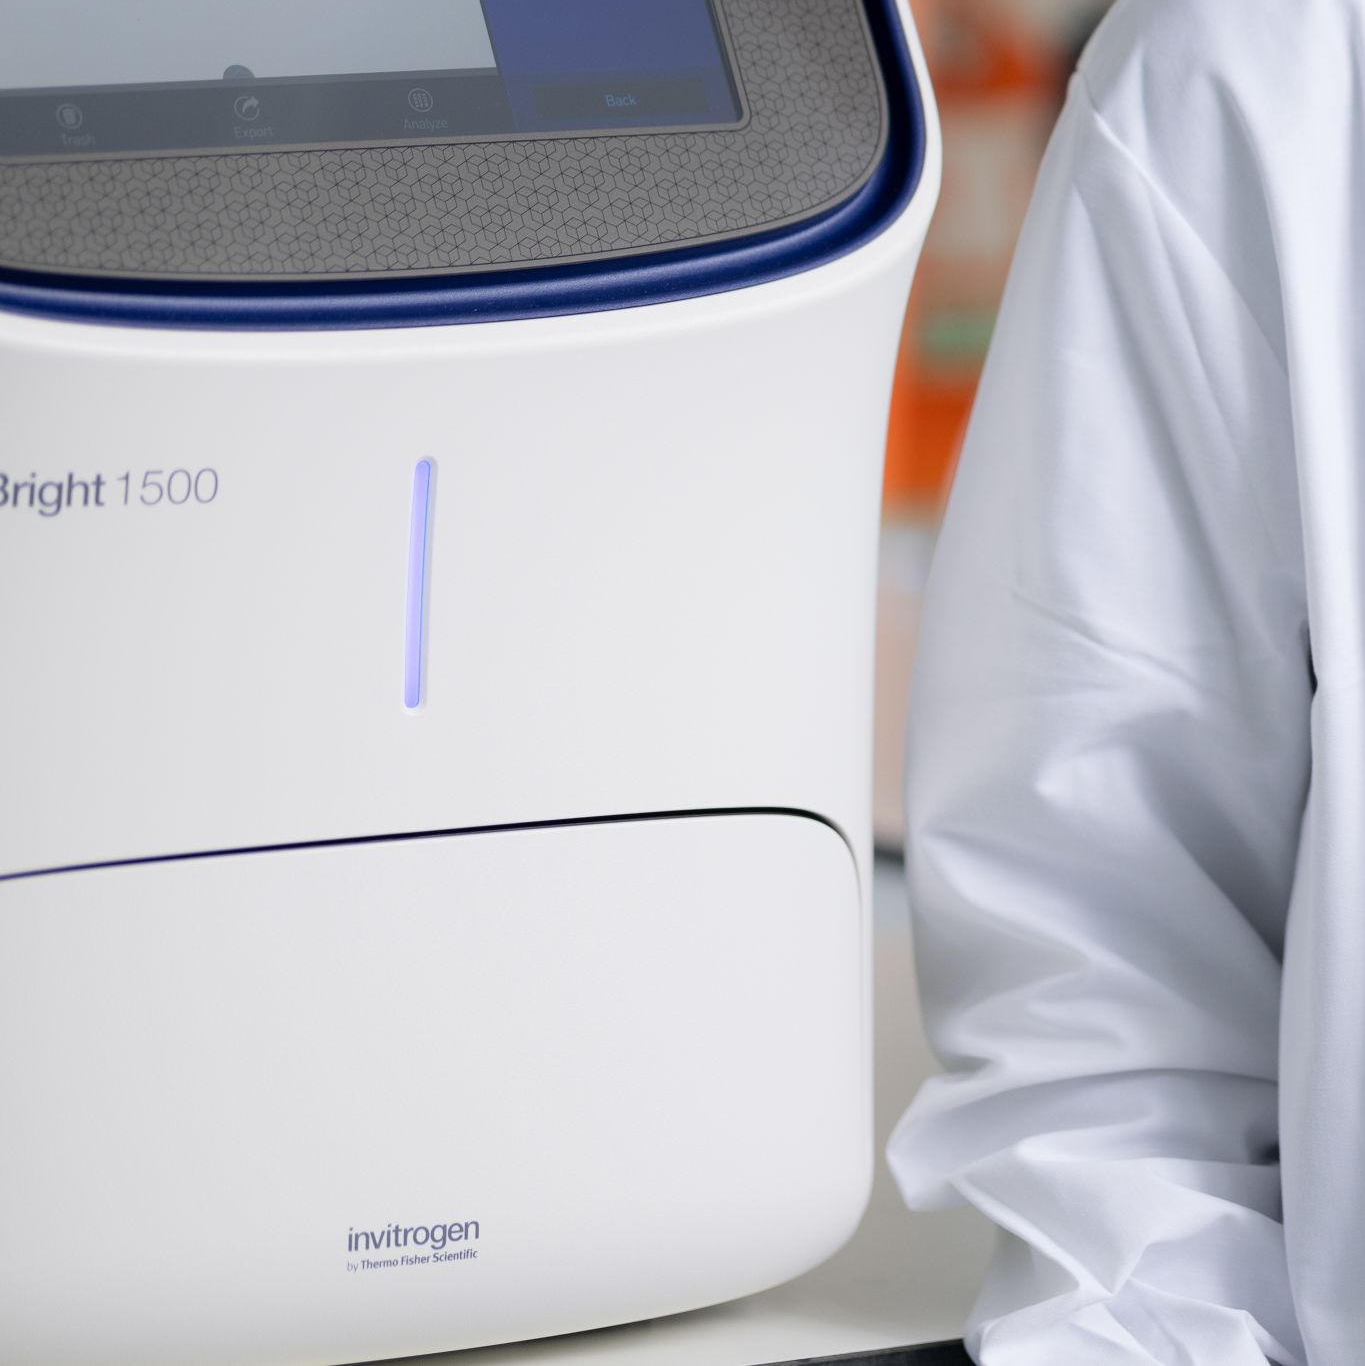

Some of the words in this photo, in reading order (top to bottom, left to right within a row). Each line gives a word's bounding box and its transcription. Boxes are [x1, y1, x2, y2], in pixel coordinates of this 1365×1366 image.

[604, 92, 638, 107] Back
[233, 124, 274, 140] Export
[402, 117, 449, 132] Analyze
[116, 467, 219, 507] 1500
[347, 1220, 480, 1253] invitrogen
[347, 1261, 359, 1274] by
[361, 1258, 399, 1271] Thermo
[400, 1254, 431, 1267] Fisher
[432, 1248, 479, 1263] Scientific
